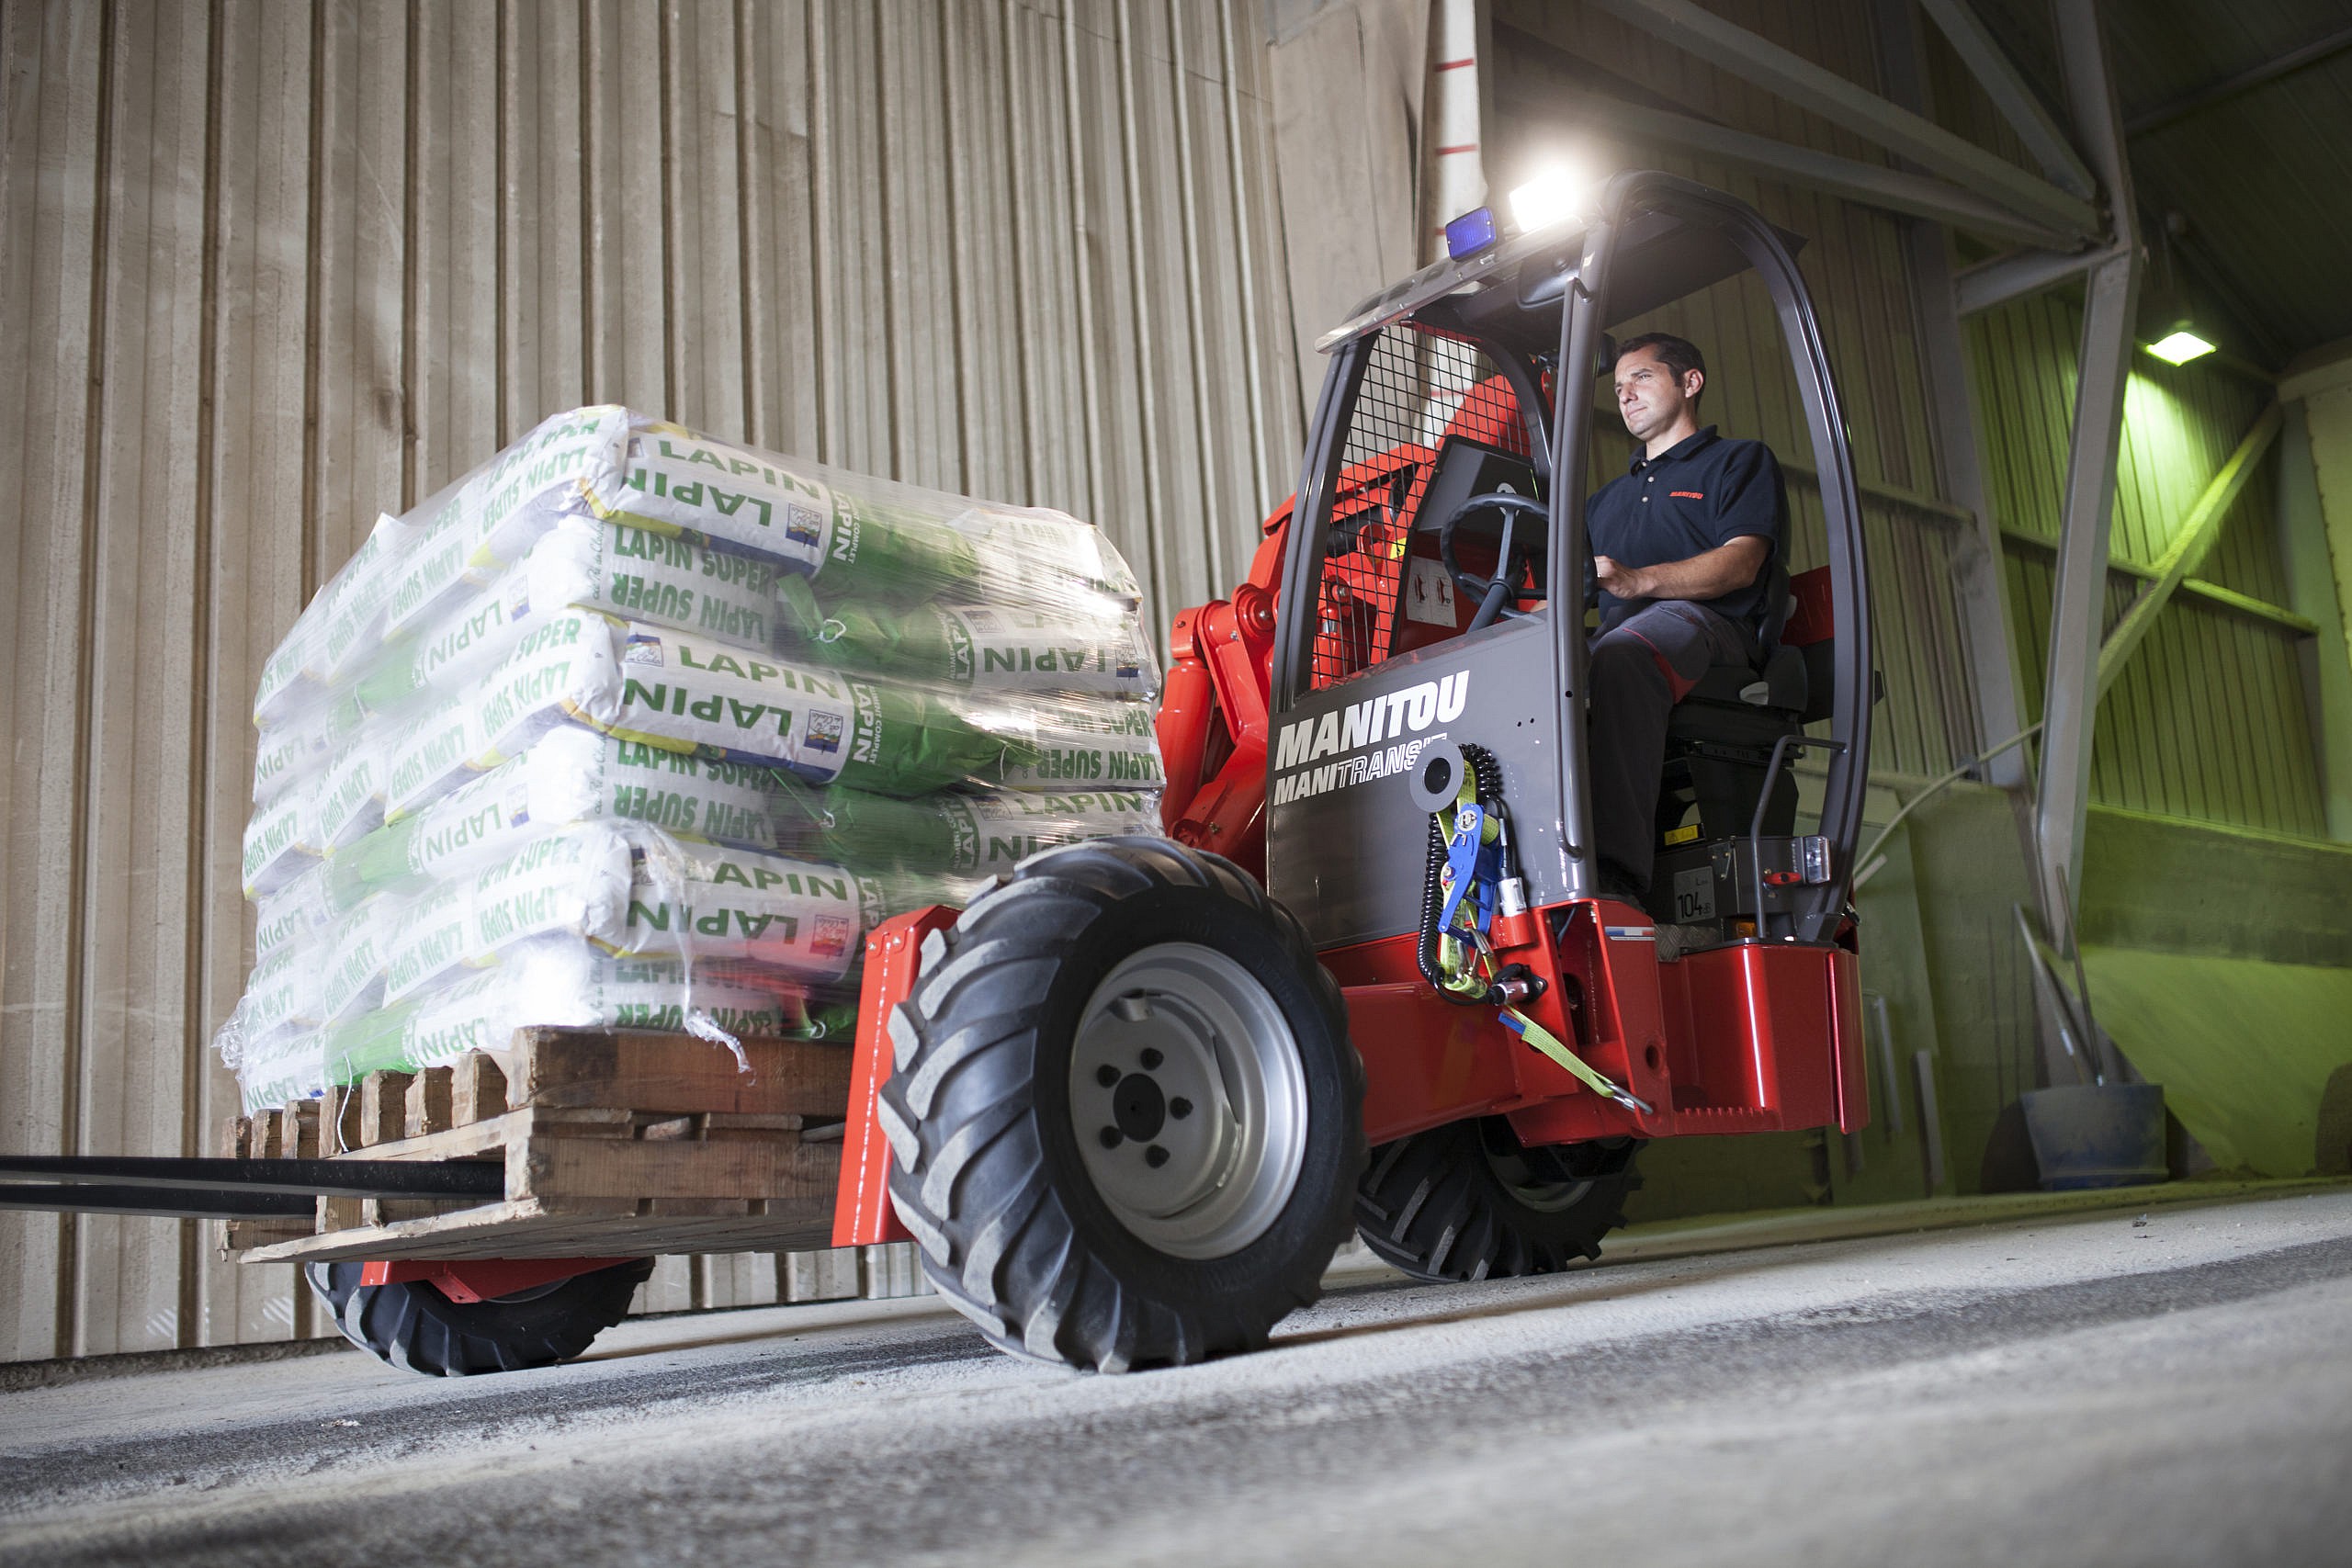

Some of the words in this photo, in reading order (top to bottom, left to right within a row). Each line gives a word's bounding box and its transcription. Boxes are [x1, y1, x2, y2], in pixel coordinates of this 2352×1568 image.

[526, 447, 587, 490] LAPIN
[658, 440, 821, 500] LAPIN
[482, 475, 521, 535] SUPER
[422, 537, 464, 592] LAPIN
[615, 525, 693, 571] LAPIN
[701, 552, 772, 599] SUPER
[610, 572, 694, 622] SUPER
[698, 594, 765, 644] LAPIN
[429, 598, 503, 671] LAPIN
[515, 617, 582, 661] SUPER
[514, 661, 571, 710] LAPIN
[678, 644, 841, 700] LAPIN
[623, 678, 793, 738] LAPIN
[852, 682, 876, 764] LAPIN
[1274, 670, 1470, 771] MANITOU
[422, 722, 466, 773] LAPIN
[869, 718, 884, 765] COMPLET
[1036, 749, 1102, 780] SUPER
[1107, 750, 1161, 781] LAPIN
[1273, 732, 1448, 807] MANITRANS
[613, 784, 698, 828] SUPER
[703, 800, 768, 841] LAPIN
[1014, 793, 1143, 815] LAPIN
[263, 809, 298, 856] LAPIN
[425, 802, 503, 863] LAPIN
[685, 862, 848, 901] APIN
[1677, 892, 1702, 919] 104
[419, 920, 464, 965] LAPIN
[626, 900, 799, 945] LAPIN
